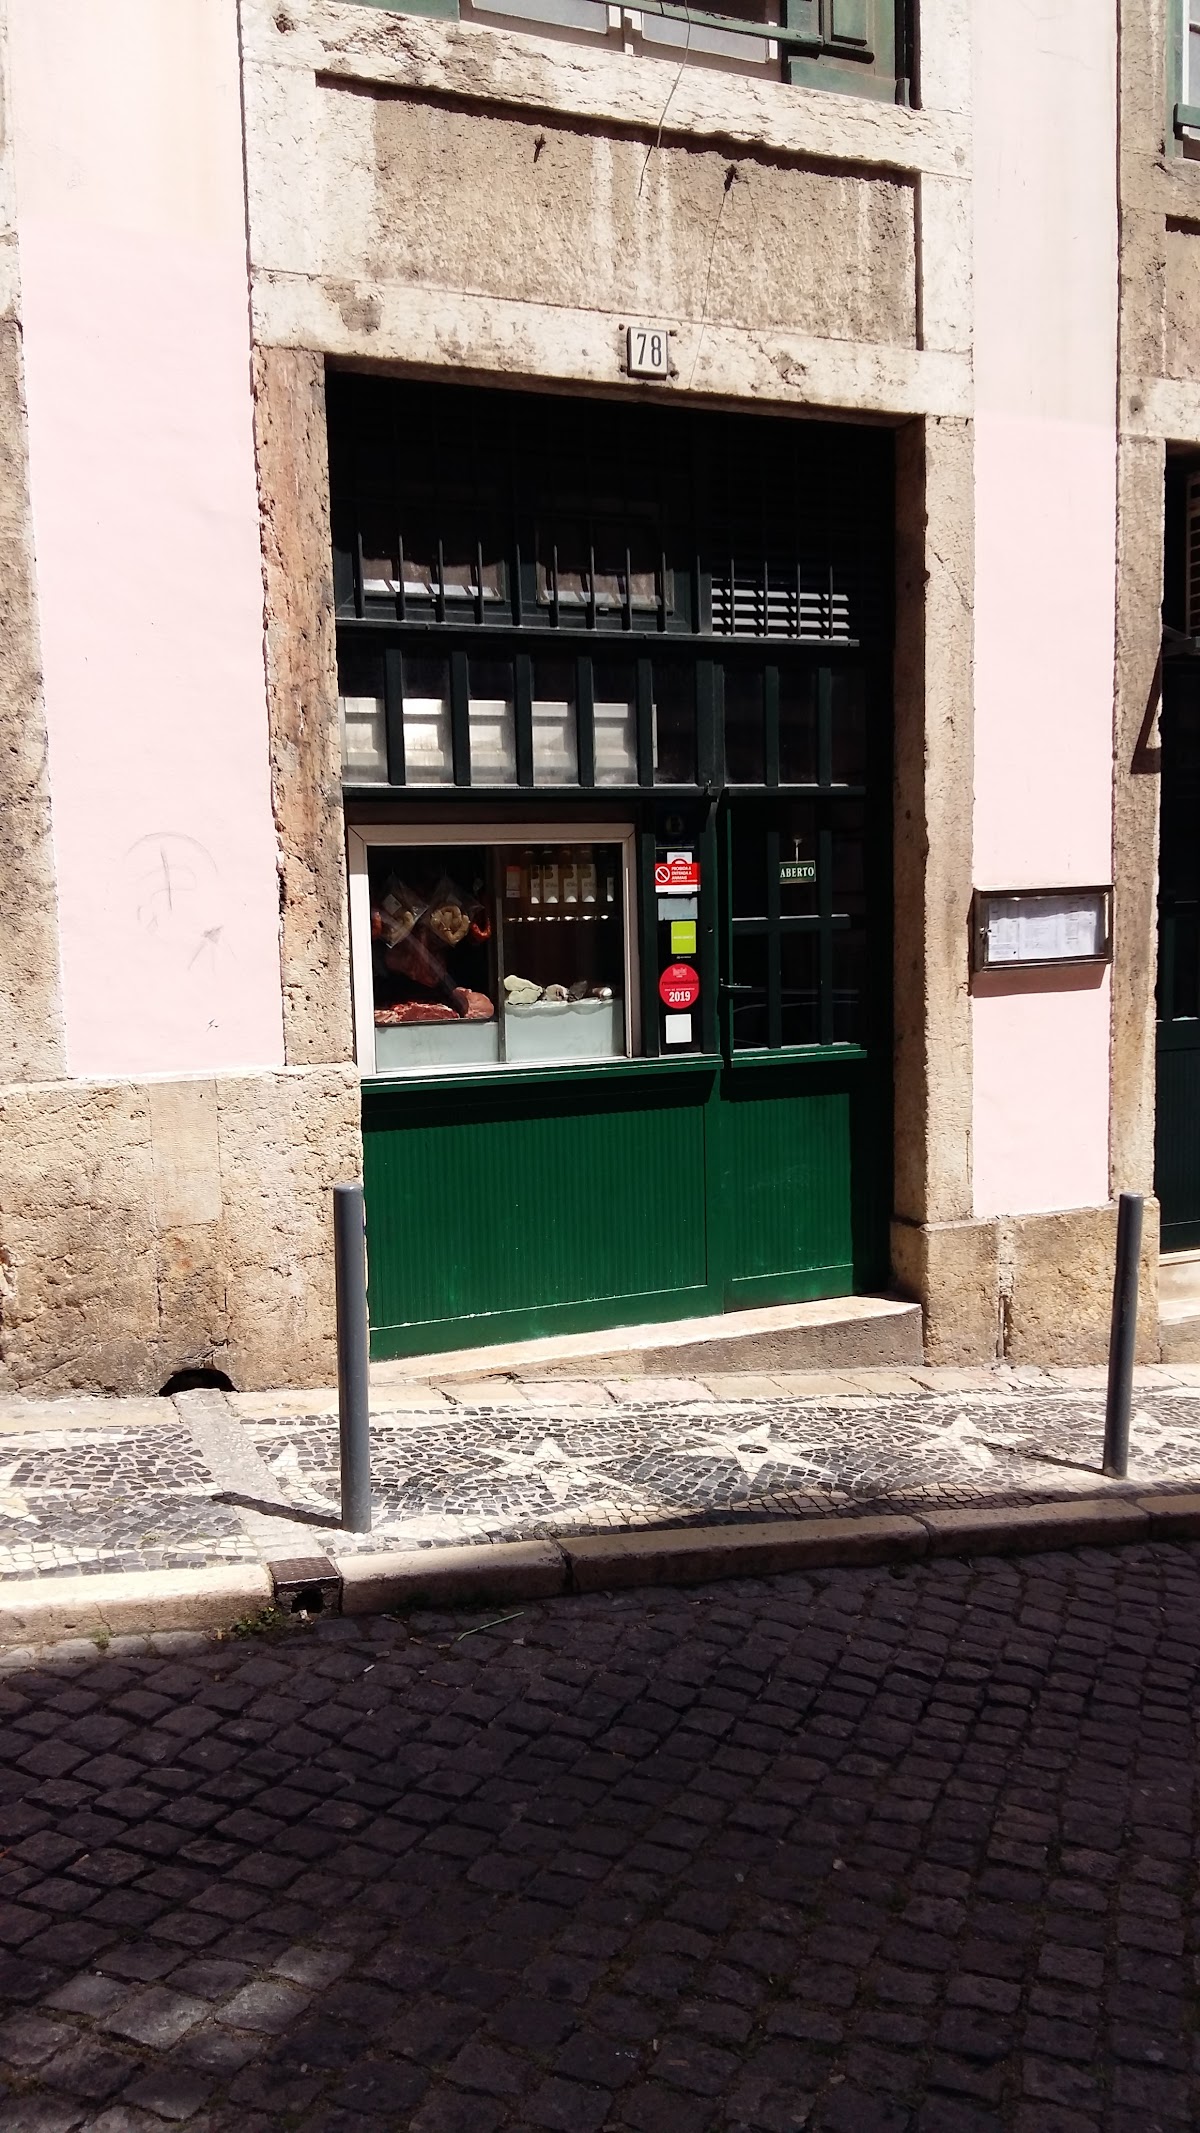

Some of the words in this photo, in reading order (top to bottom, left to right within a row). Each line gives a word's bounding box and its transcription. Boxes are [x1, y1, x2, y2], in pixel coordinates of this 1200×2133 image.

[637, 333, 662, 367] 78
[780, 867, 815, 878] ABERTO
[669, 991, 691, 1002] 2019
